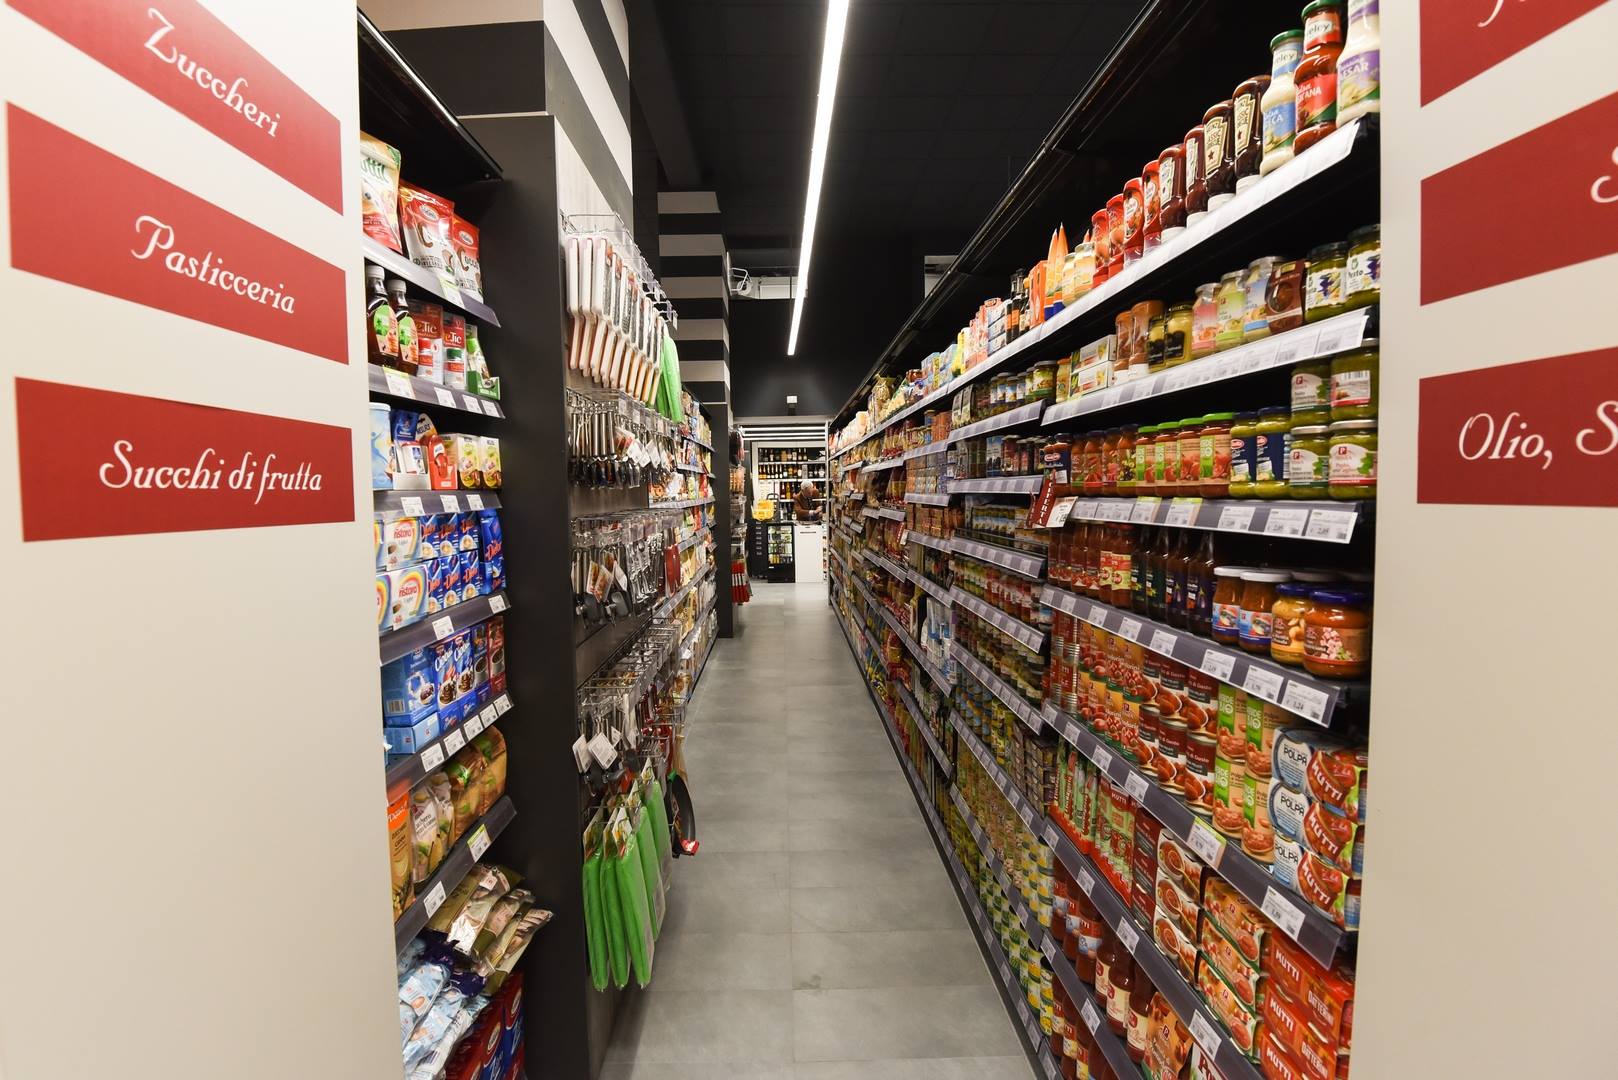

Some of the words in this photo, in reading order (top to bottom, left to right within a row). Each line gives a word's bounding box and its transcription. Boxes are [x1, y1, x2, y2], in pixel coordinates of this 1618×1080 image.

[144, 7, 280, 138] Zuccheri
[131, 215, 295, 315] Pasticceria
[1458, 412, 1553, 470] Olio,
[99, 440, 225, 490] Succhi
[228, 452, 254, 491] di
[253, 453, 323, 506] frutta
[1283, 747, 1308, 766] POLPA
[1311, 761, 1343, 801] MUTTI
[1280, 797, 1305, 816] POLPA
[1308, 812, 1338, 855] MUTTI
[1301, 862, 1331, 905] MUTTI
[1275, 950, 1300, 982] MUTTI
[1270, 998, 1294, 1032] MUTTI
[1307, 990, 1334, 1026] DATTERINI
[1266, 1047, 1292, 1080] MUTTI
[1301, 1041, 1329, 1079] DATTERINI
